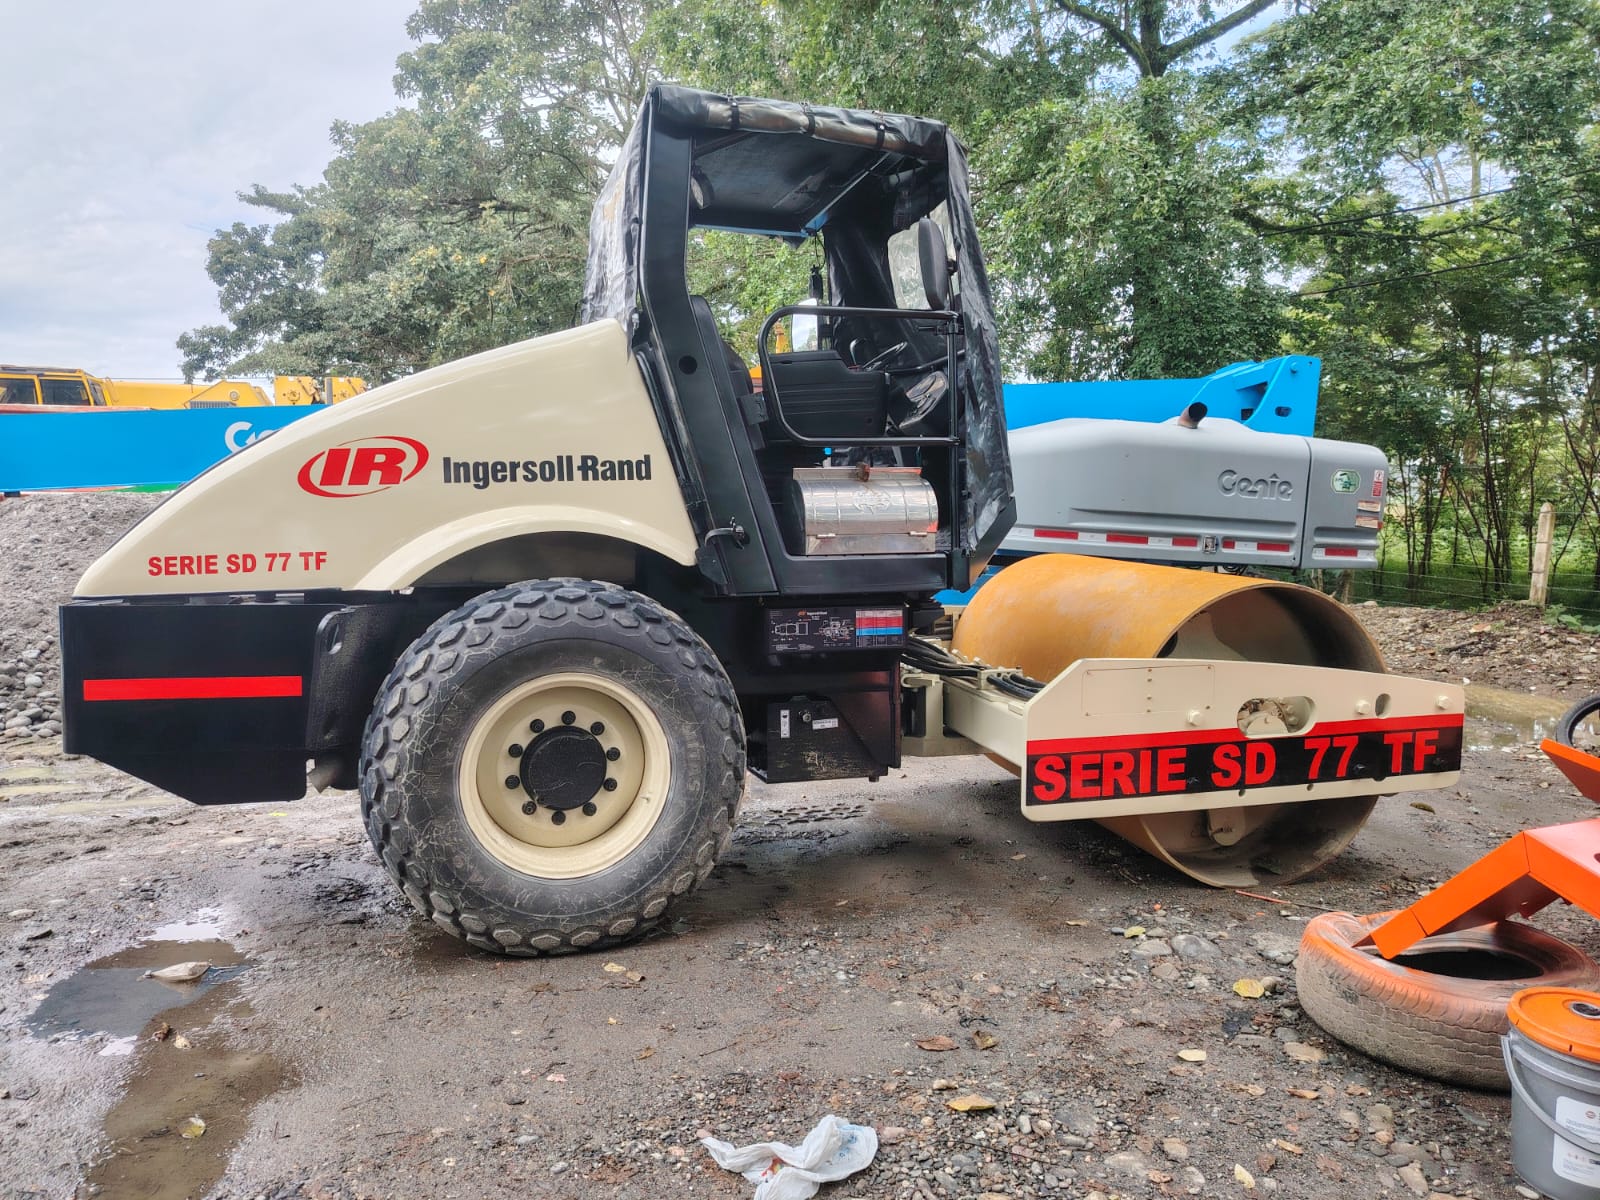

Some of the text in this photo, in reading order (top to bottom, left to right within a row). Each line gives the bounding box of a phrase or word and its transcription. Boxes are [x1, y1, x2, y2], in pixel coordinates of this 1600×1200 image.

[319, 447, 407, 486] IR
[443, 454, 652, 490] Ingersoll-Rand
[1217, 469, 1294, 501] Genie
[148, 551, 327, 577] SERIE SD 77 TF
[1032, 730, 1440, 801] SERIE SD 77 TF
